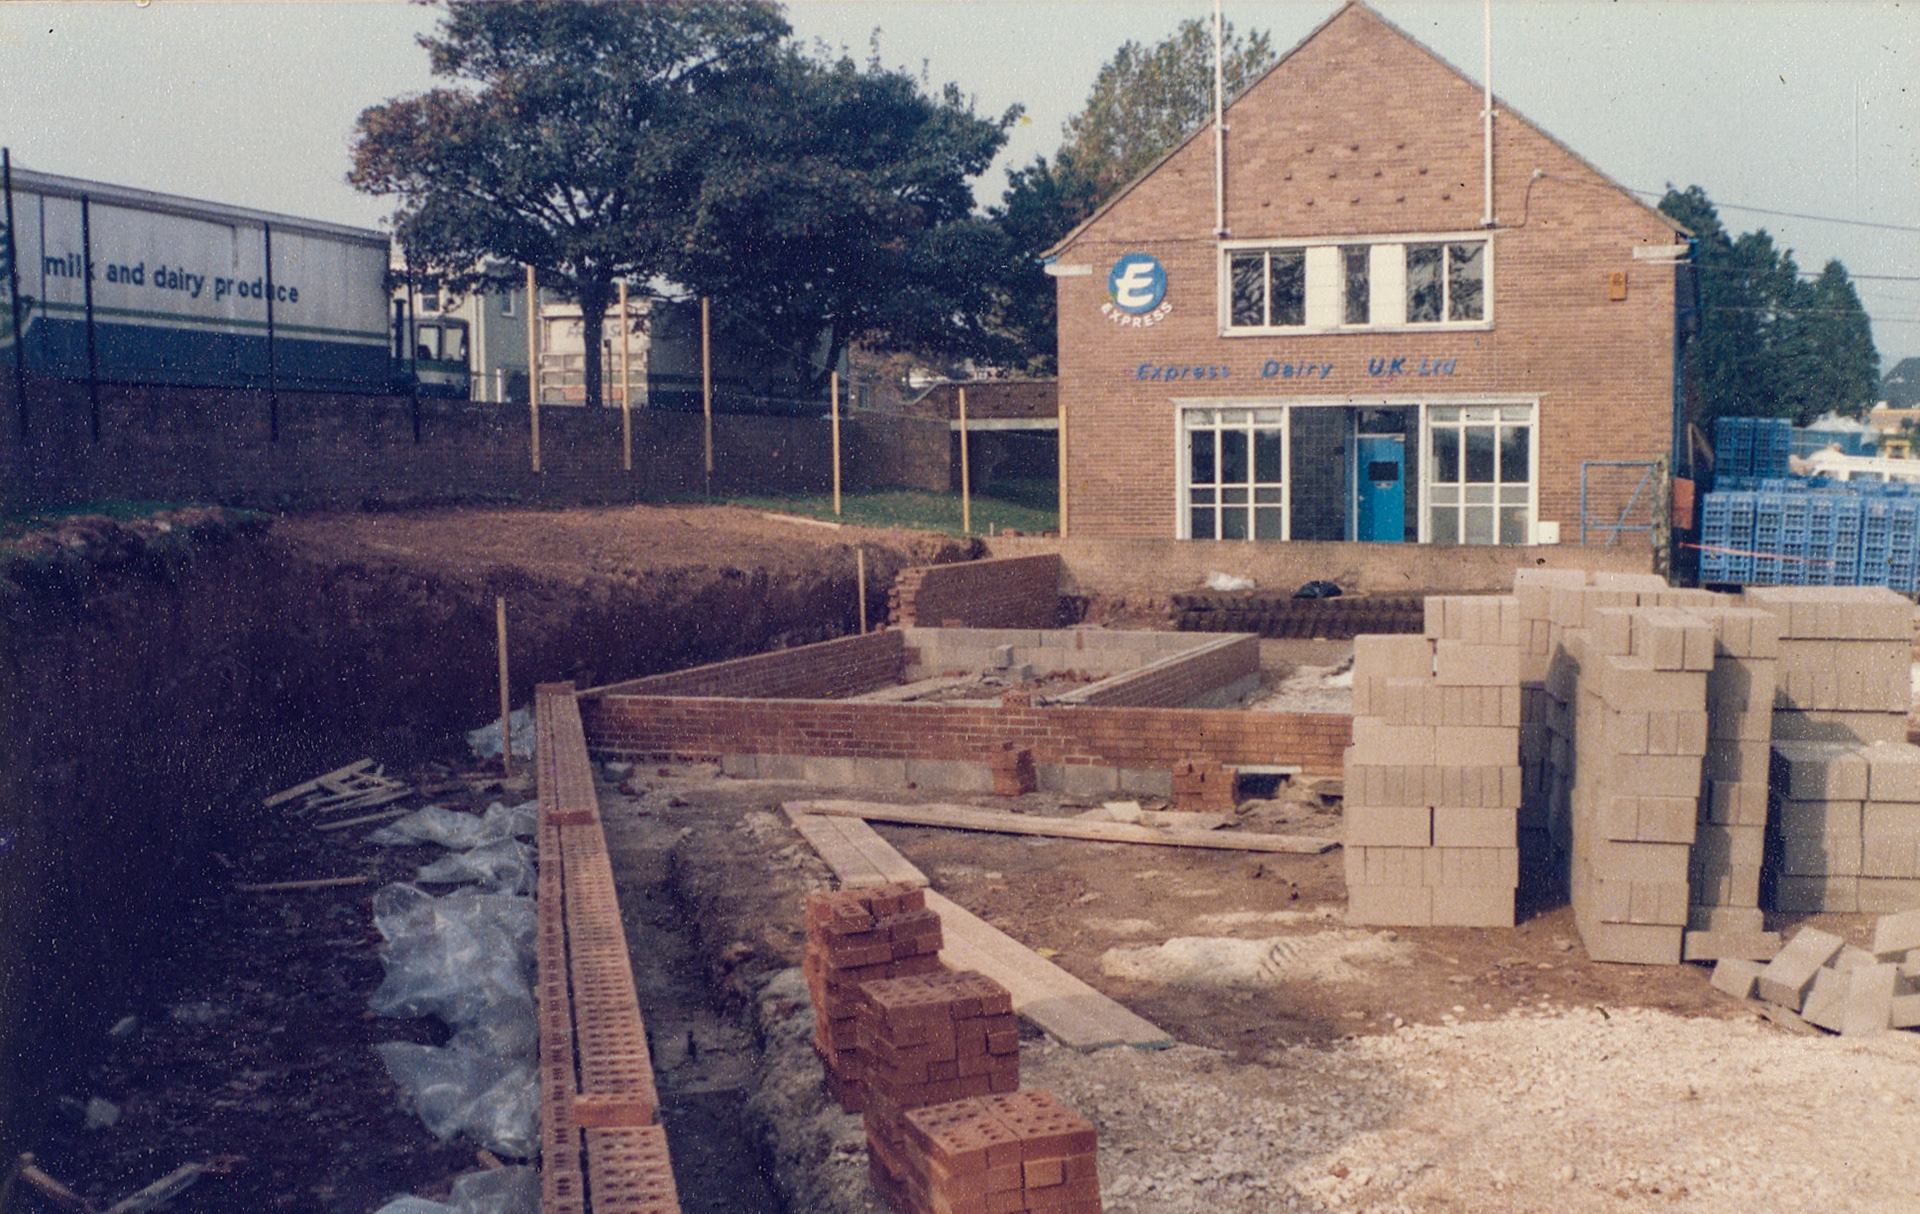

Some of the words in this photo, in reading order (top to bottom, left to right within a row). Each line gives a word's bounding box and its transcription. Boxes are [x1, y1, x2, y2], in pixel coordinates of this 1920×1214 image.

[106, 262, 145, 286] and
[154, 265, 204, 298] dairy
[1101, 302, 1173, 328] EXPRESS
[1135, 363, 1230, 382] Express
[1263, 360, 1333, 379] Dairy
[1418, 357, 1457, 375] Ltd
